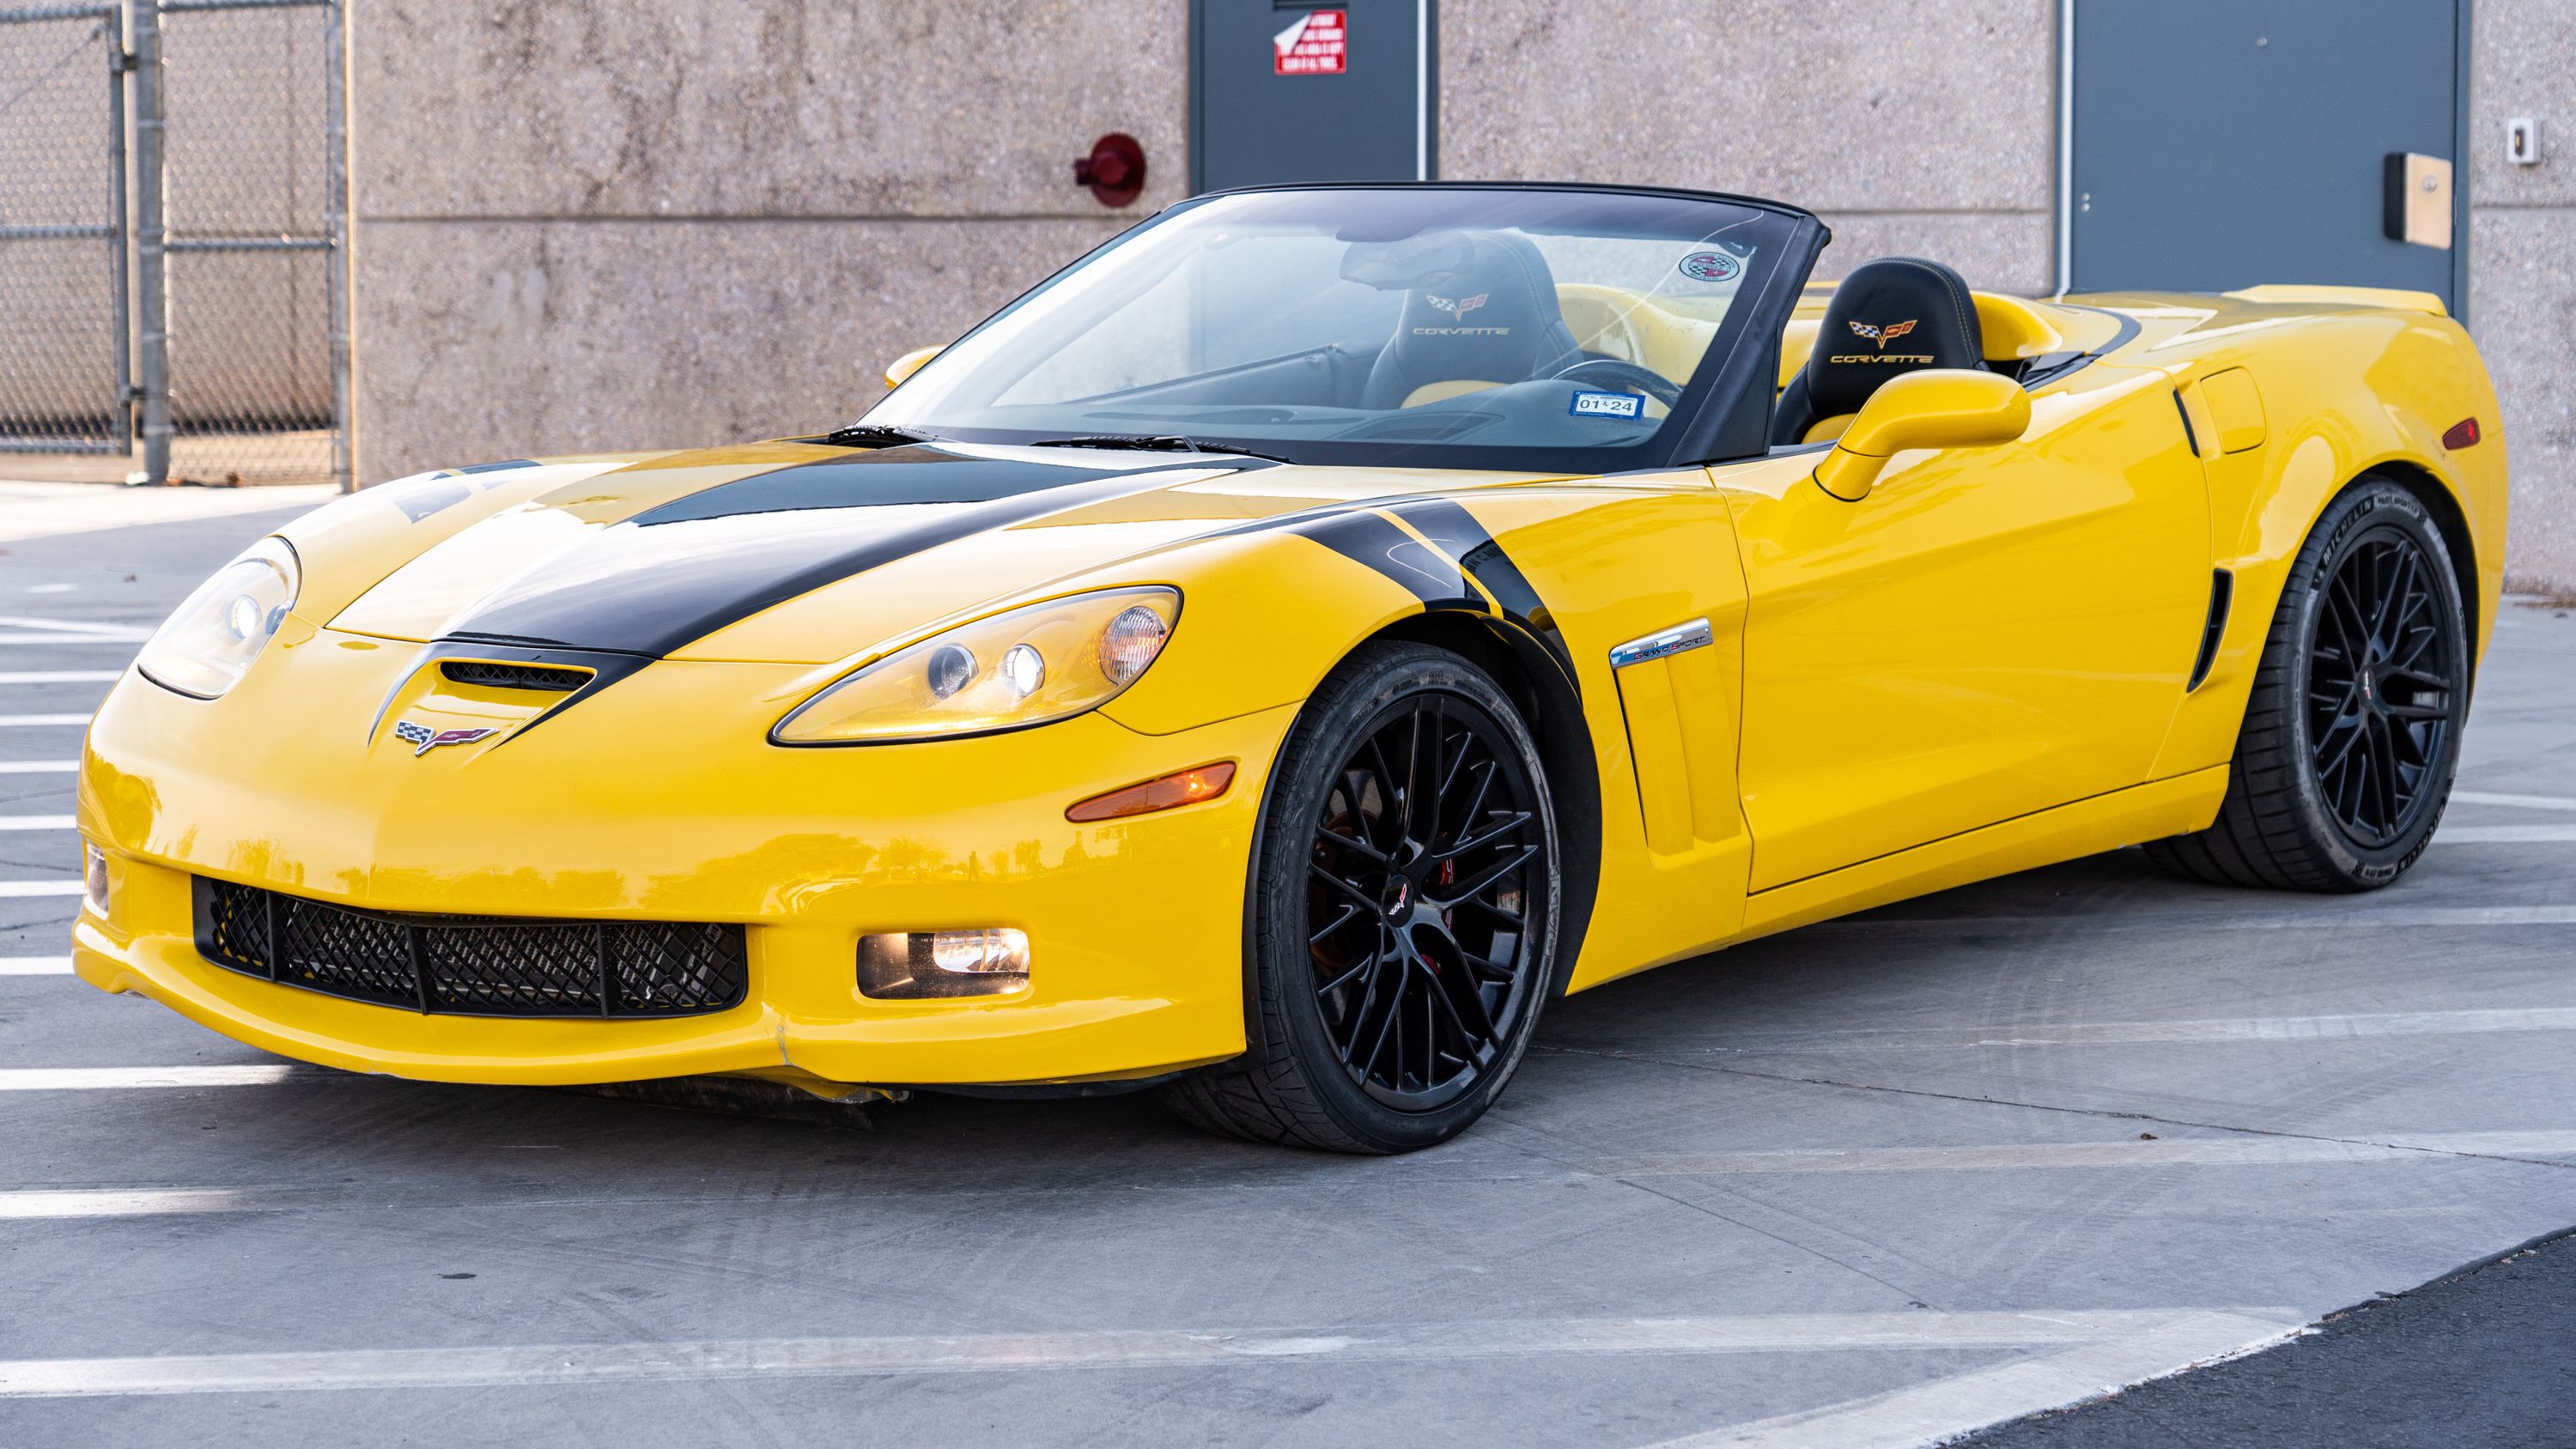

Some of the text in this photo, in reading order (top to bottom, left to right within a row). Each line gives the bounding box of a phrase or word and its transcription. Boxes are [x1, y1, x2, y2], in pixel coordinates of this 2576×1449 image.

[1413, 327, 1510, 336] CORVETTE
[1830, 355, 1935, 364] CORVETTE
[1579, 399, 1632, 412] 01 24
[2322, 497, 2373, 566] MICHELIN
[1633, 635, 1705, 660] GRAND SPORT
